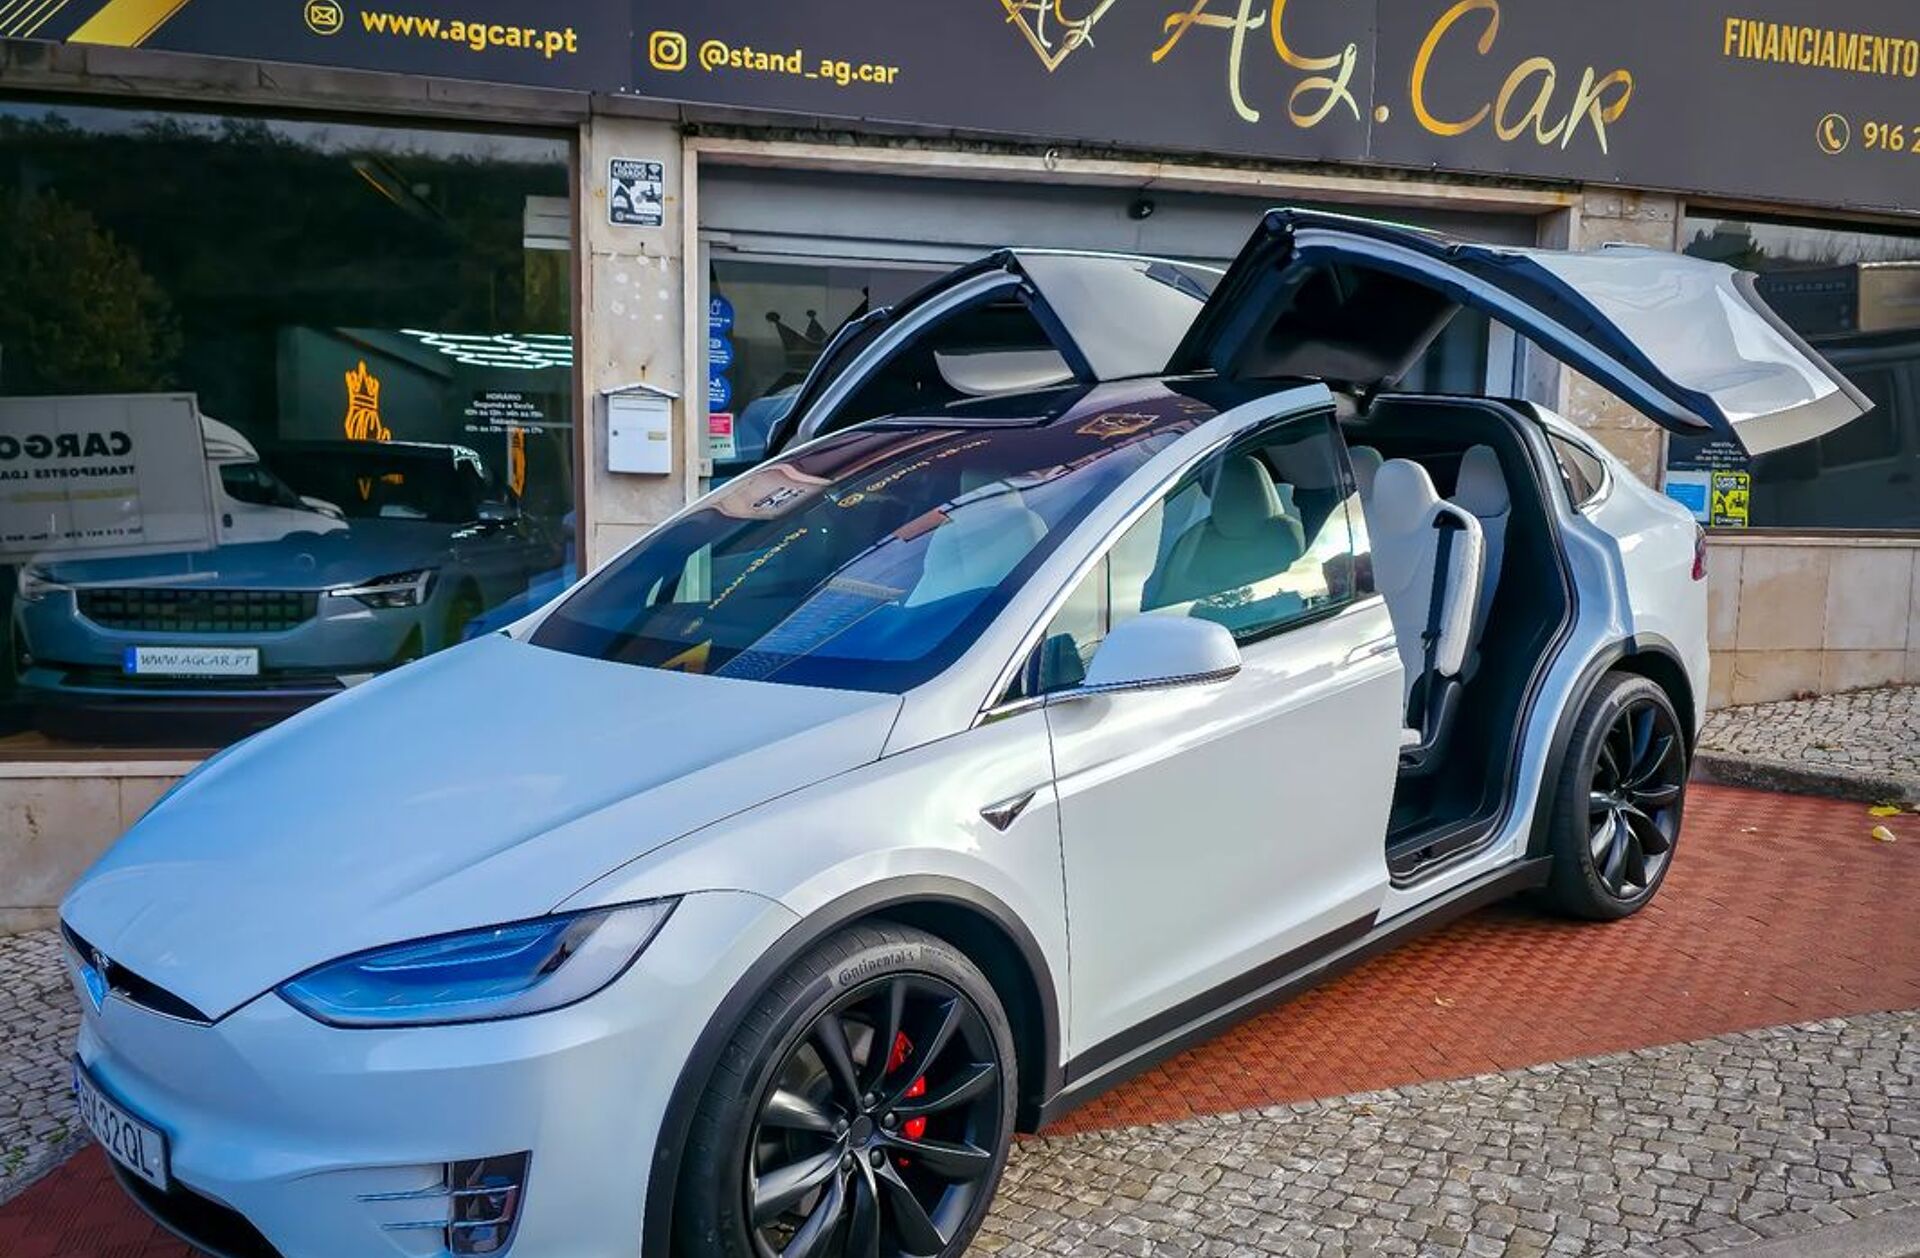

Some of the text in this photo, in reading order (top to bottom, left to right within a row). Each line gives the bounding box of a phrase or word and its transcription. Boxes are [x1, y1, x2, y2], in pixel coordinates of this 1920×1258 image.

[361, 10, 577, 58] www.agcar.pt
[1724, 17, 1920, 78] FINANCIAMENTO
[699, 40, 899, 86] @stand_ag.car
[1863, 121, 1905, 151] 916
